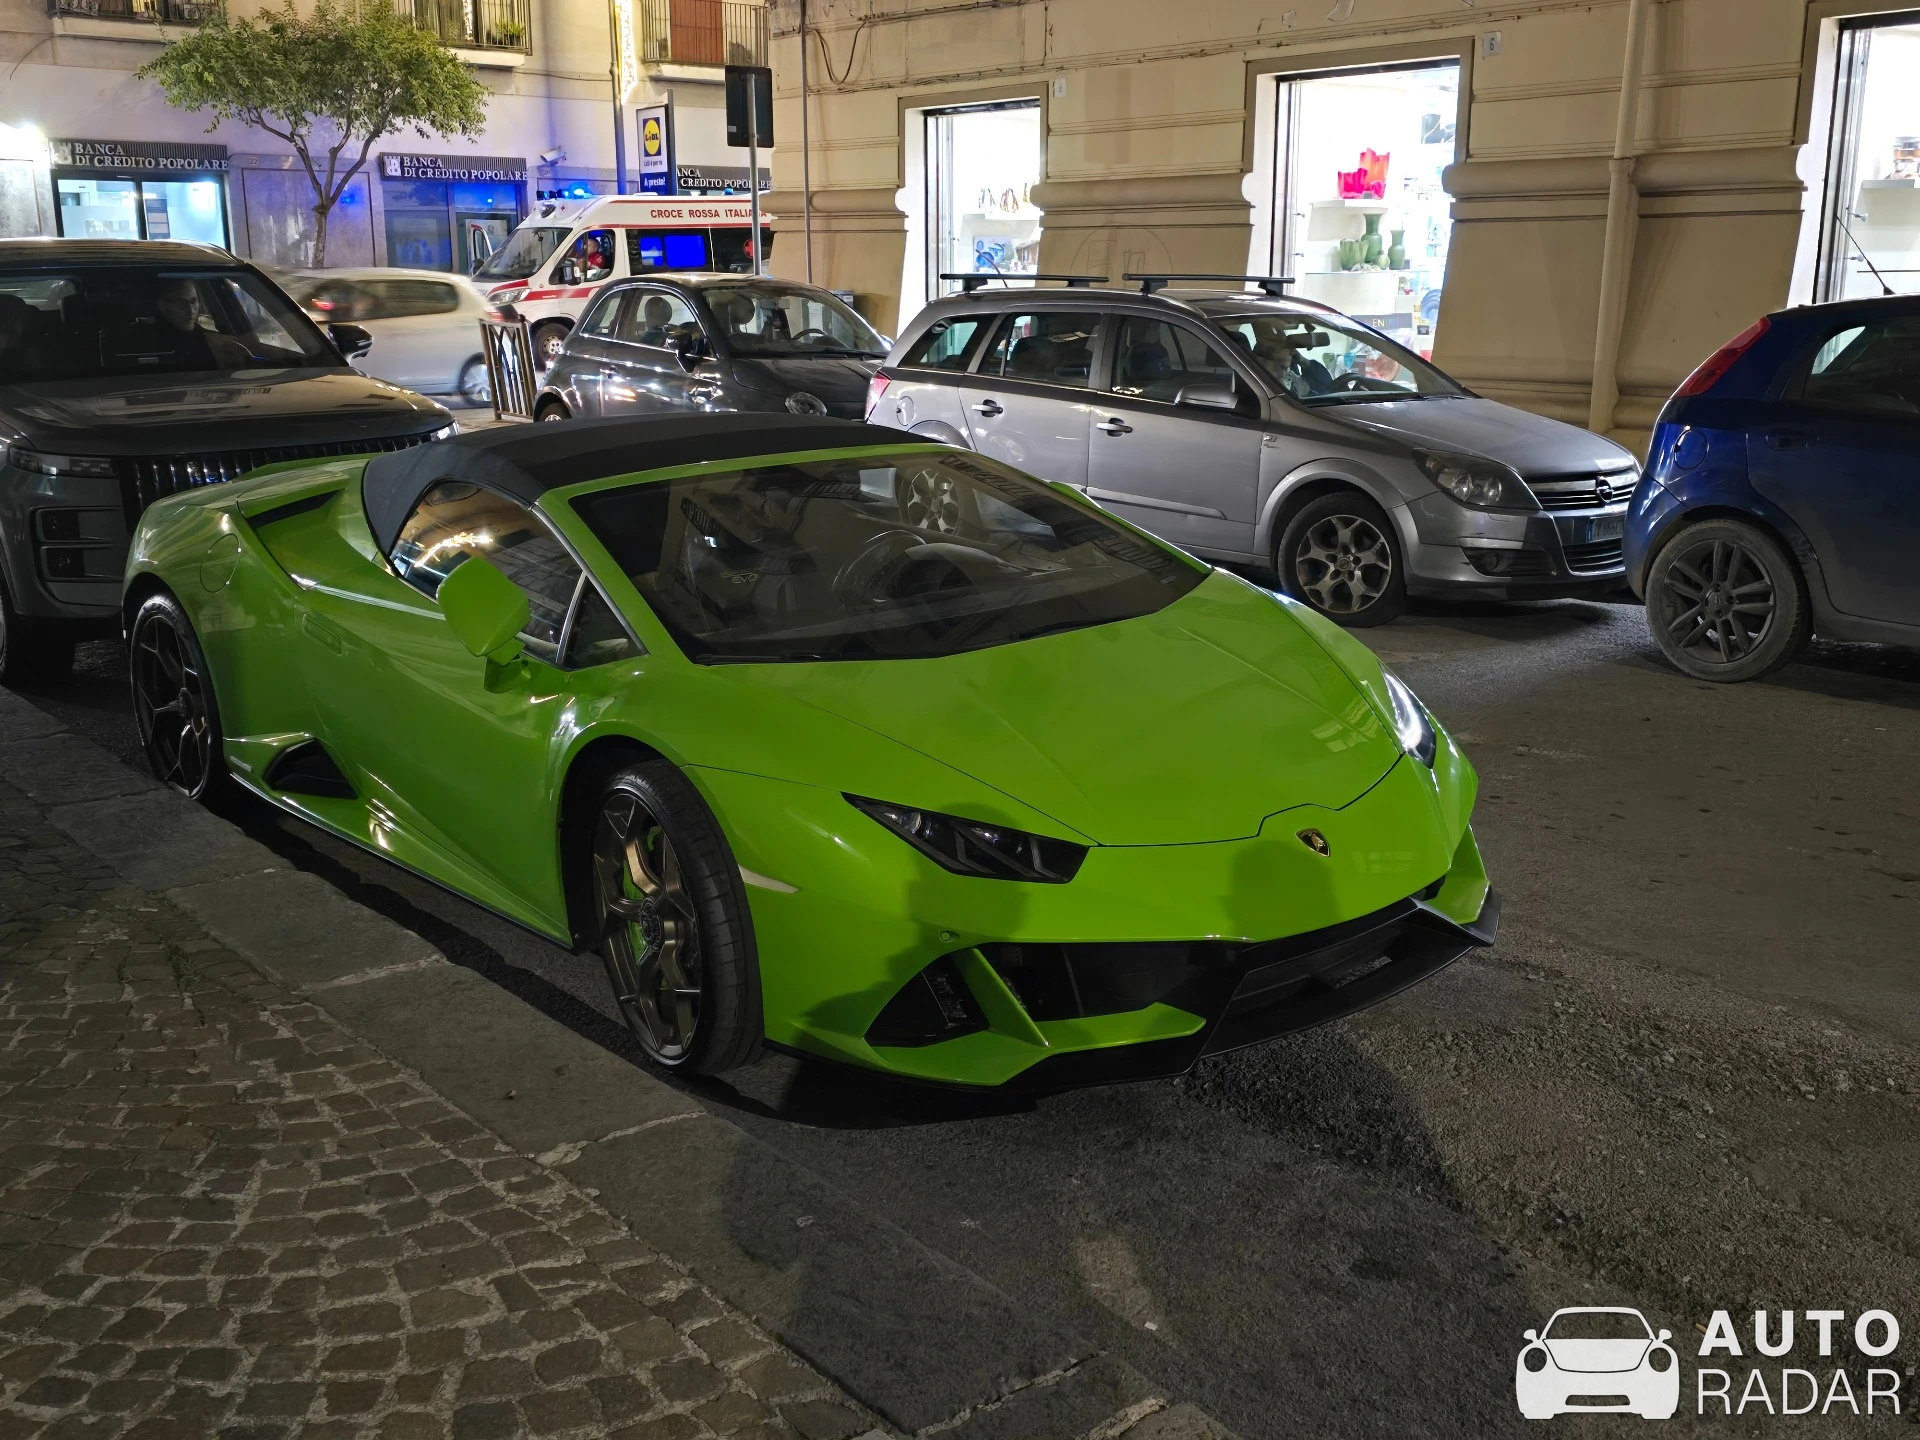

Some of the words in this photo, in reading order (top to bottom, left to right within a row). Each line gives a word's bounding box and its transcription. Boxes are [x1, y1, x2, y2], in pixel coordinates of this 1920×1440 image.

[74, 143, 125, 156] BANCA
[75, 156, 91, 167] DI
[94, 157, 155, 169] CREDITO
[158, 158, 228, 170] POPOLARE
[403, 157, 443, 167] BANCA
[404, 168, 416, 177] DI
[419, 168, 468, 179] CREDITO
[471, 169, 528, 180] POPOLARE
[676, 167, 701, 177] ANCA
[681, 177, 722, 188] CREDITO
[650, 209, 683, 218] CROCE
[688, 209, 720, 218] ROSSA
[725, 208, 768, 218] ITALIAA
